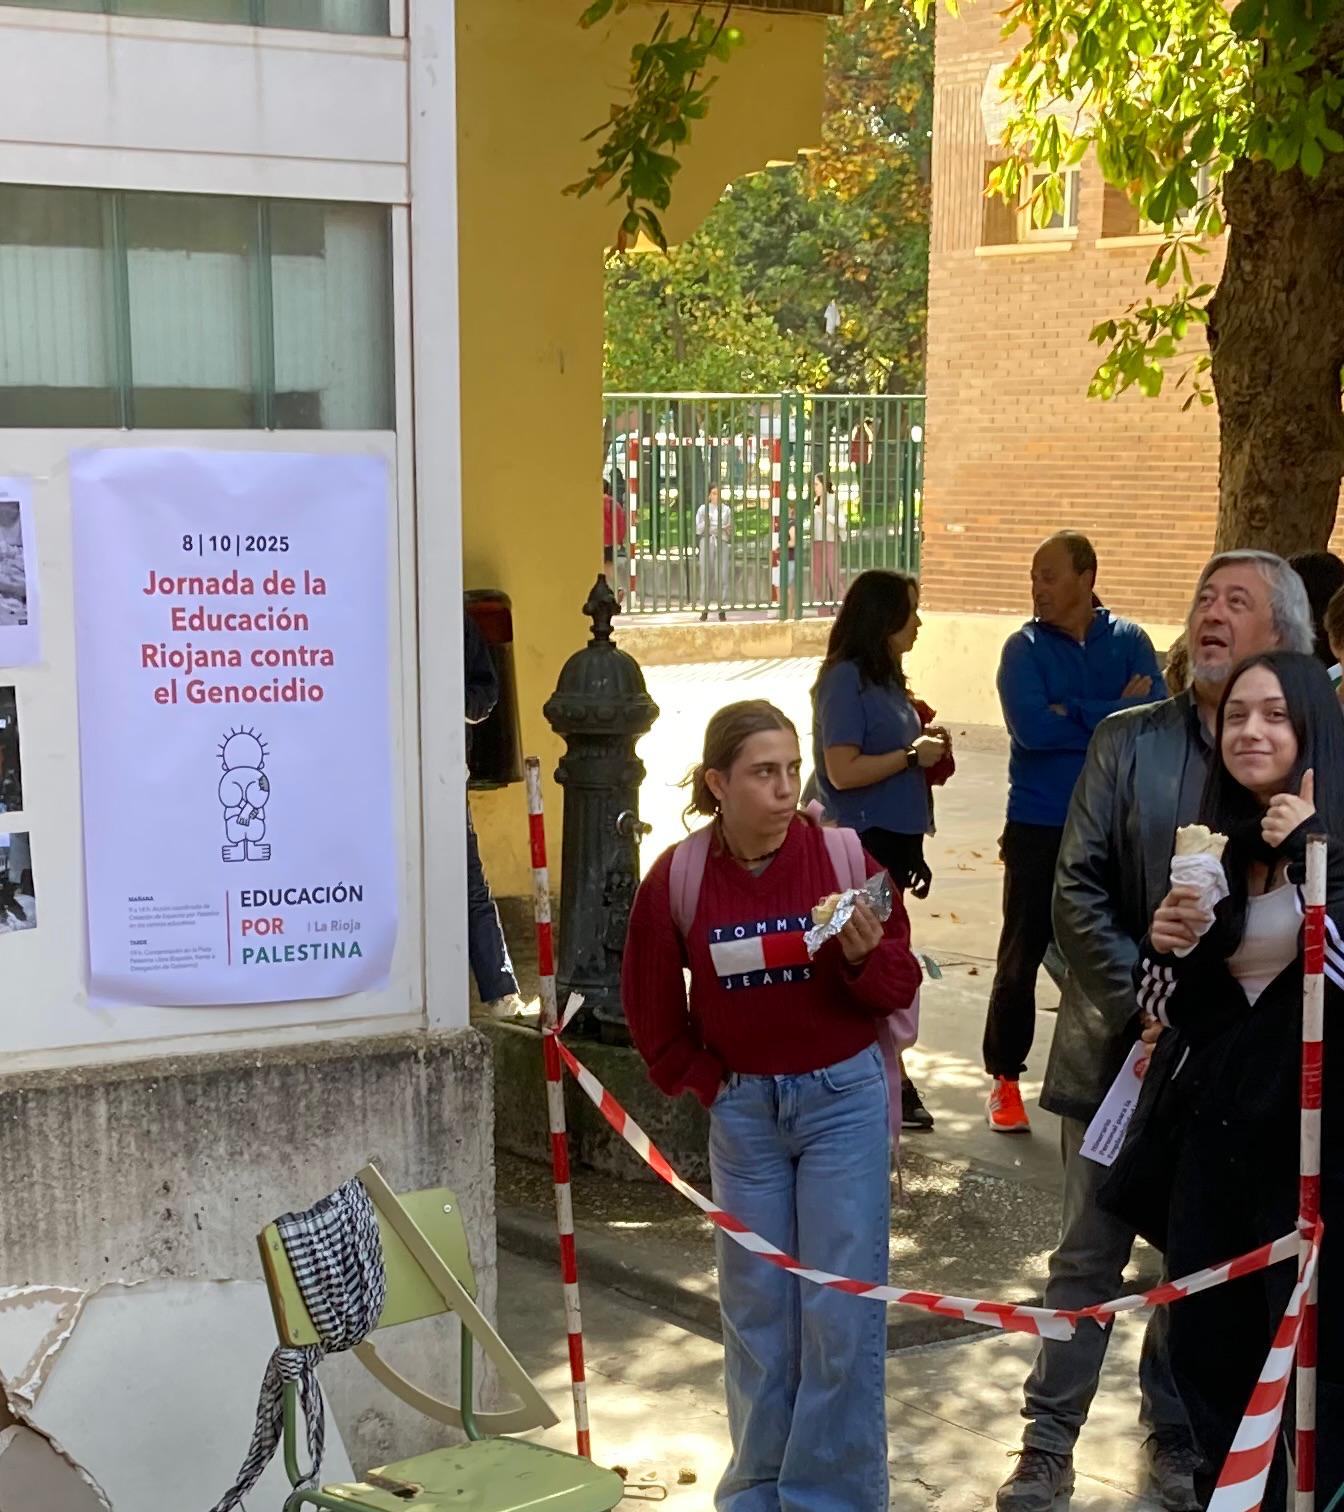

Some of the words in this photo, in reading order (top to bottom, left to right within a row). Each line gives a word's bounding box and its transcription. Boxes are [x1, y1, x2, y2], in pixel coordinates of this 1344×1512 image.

[142, 569, 255, 596] Jornada
[262, 569, 296, 596] de
[303, 569, 327, 596] la
[170, 606, 309, 632] Educación
[141, 642, 242, 675] Riojana
[250, 644, 335, 668] contra
[154, 678, 178, 705] el
[186, 677, 325, 705] Genocidio
[240, 881, 364, 908] EDUCACIÓN
[241, 917, 284, 937] POR
[314, 921, 327, 933] La
[330, 918, 362, 934] Rioja
[714, 917, 807, 940] TOMMY
[242, 941, 364, 965] PALESTINA
[726, 968, 811, 988] JEANS
